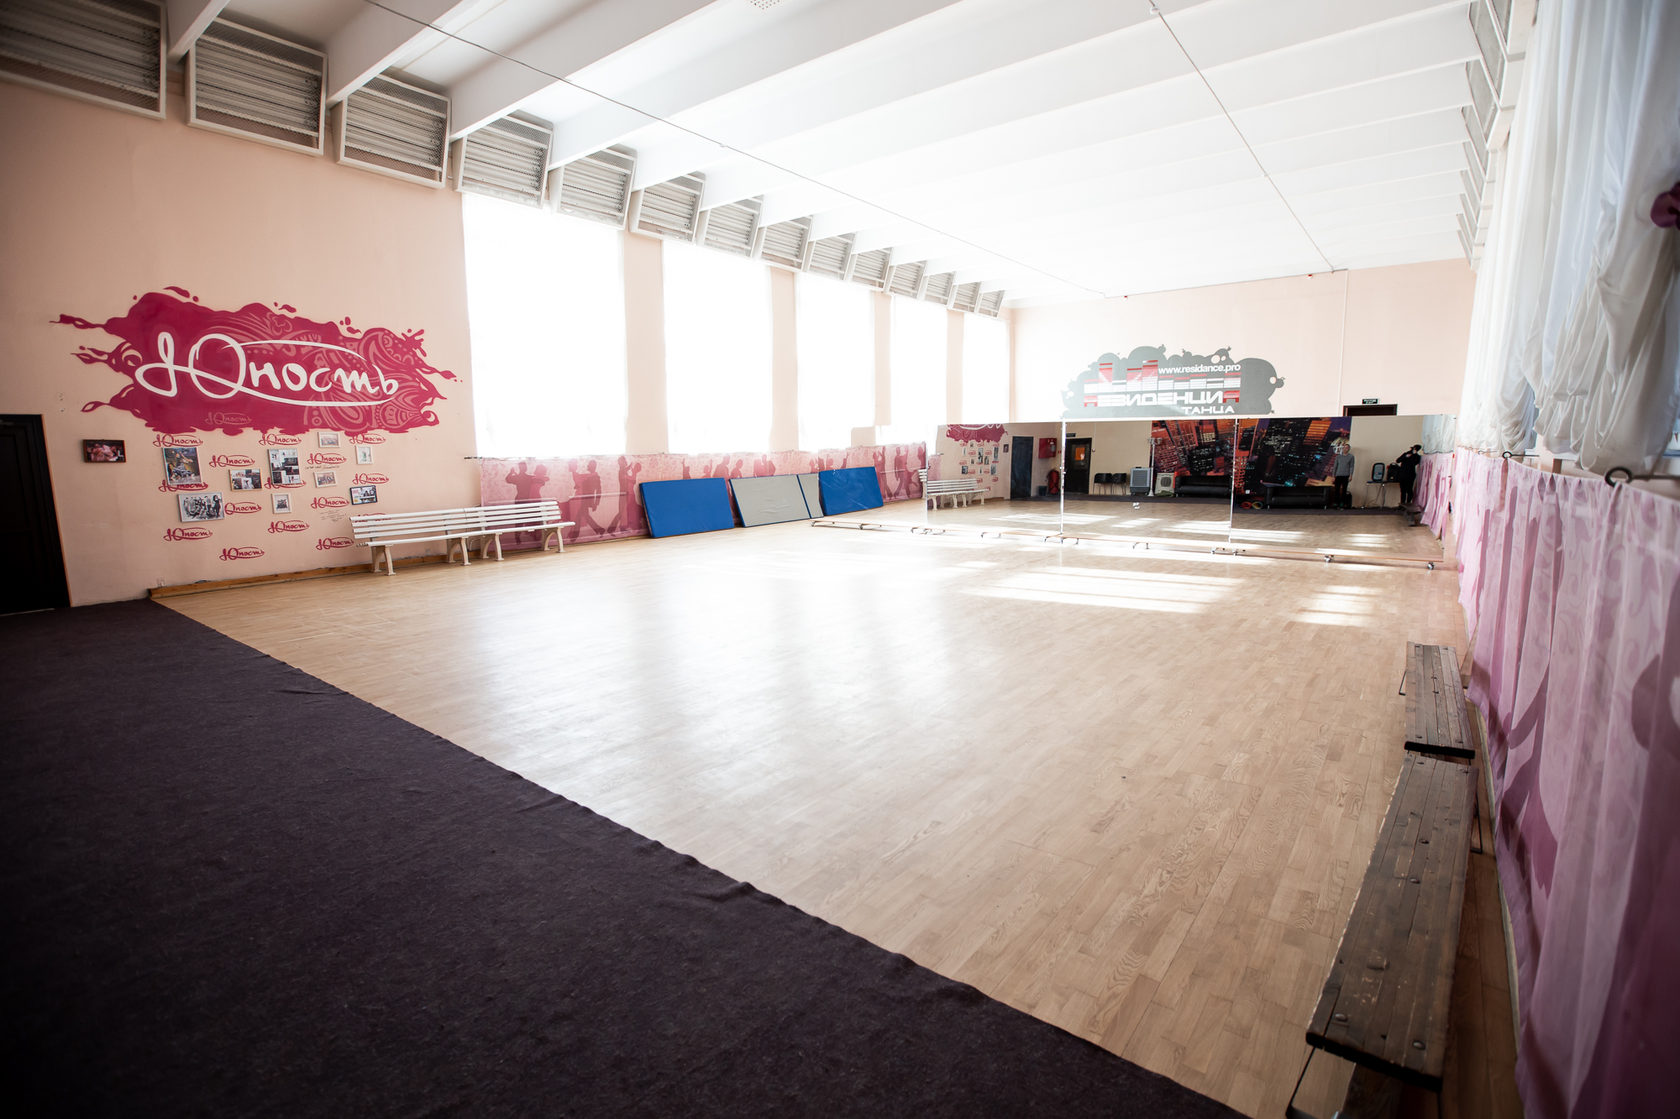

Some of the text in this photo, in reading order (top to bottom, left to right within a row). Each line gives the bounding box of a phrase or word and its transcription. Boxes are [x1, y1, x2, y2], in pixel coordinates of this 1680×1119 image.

[134, 331, 400, 407] Юность
[1158, 364, 1241, 374] www.residance.pro
[1181, 405, 1235, 415] ТАНЦА
[208, 454, 255, 467] Юность
[306, 452, 347, 465] Юность
[352, 473, 390, 485] Юность
[310, 496, 350, 509] Юность
[267, 519, 310, 534] Юность
[163, 526, 213, 541] Юность
[315, 536, 355, 550] Юность
[218, 546, 265, 561] Юность
